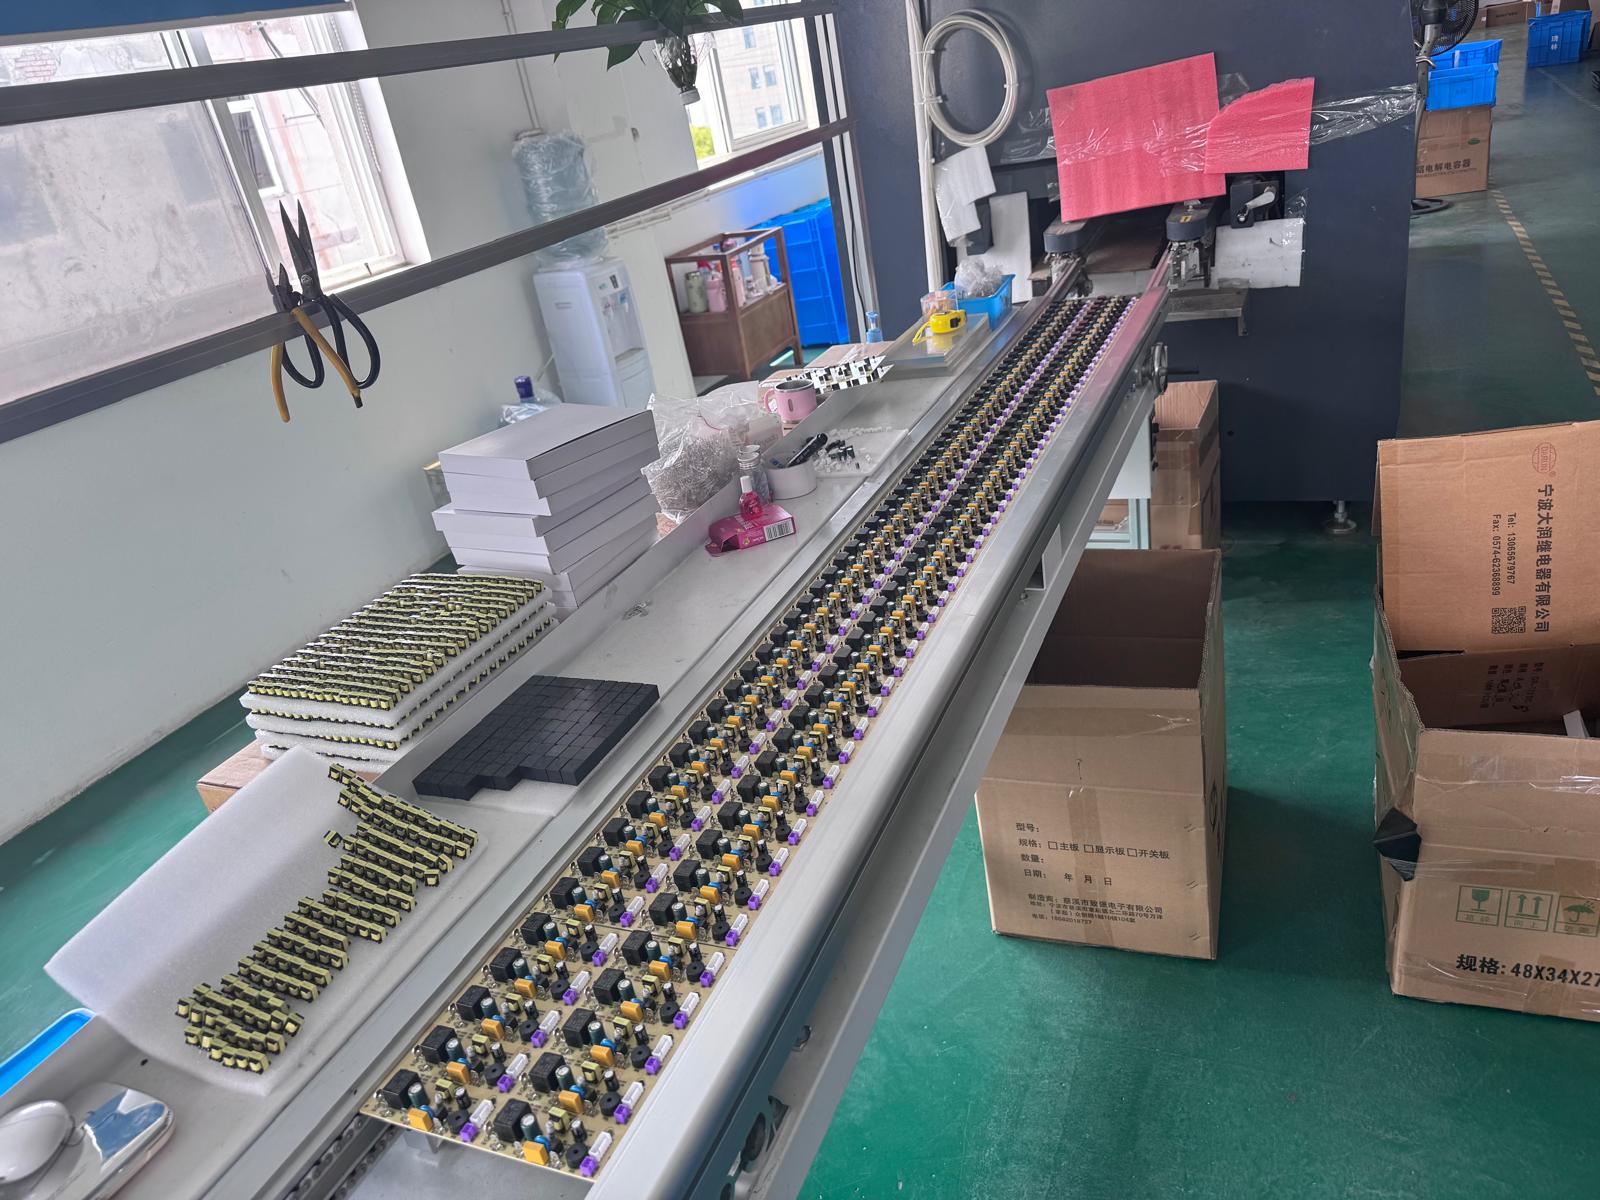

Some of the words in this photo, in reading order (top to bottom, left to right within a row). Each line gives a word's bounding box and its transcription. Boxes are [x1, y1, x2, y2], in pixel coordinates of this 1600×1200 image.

[1492, 514, 1501, 532] Fax:
[1507, 512, 1517, 529] Tel:
[1534, 484, 1554, 633] 宁波大润继电器有限公司
[1084, 875, 1093, 884] 月
[1104, 877, 1113, 886] 日
